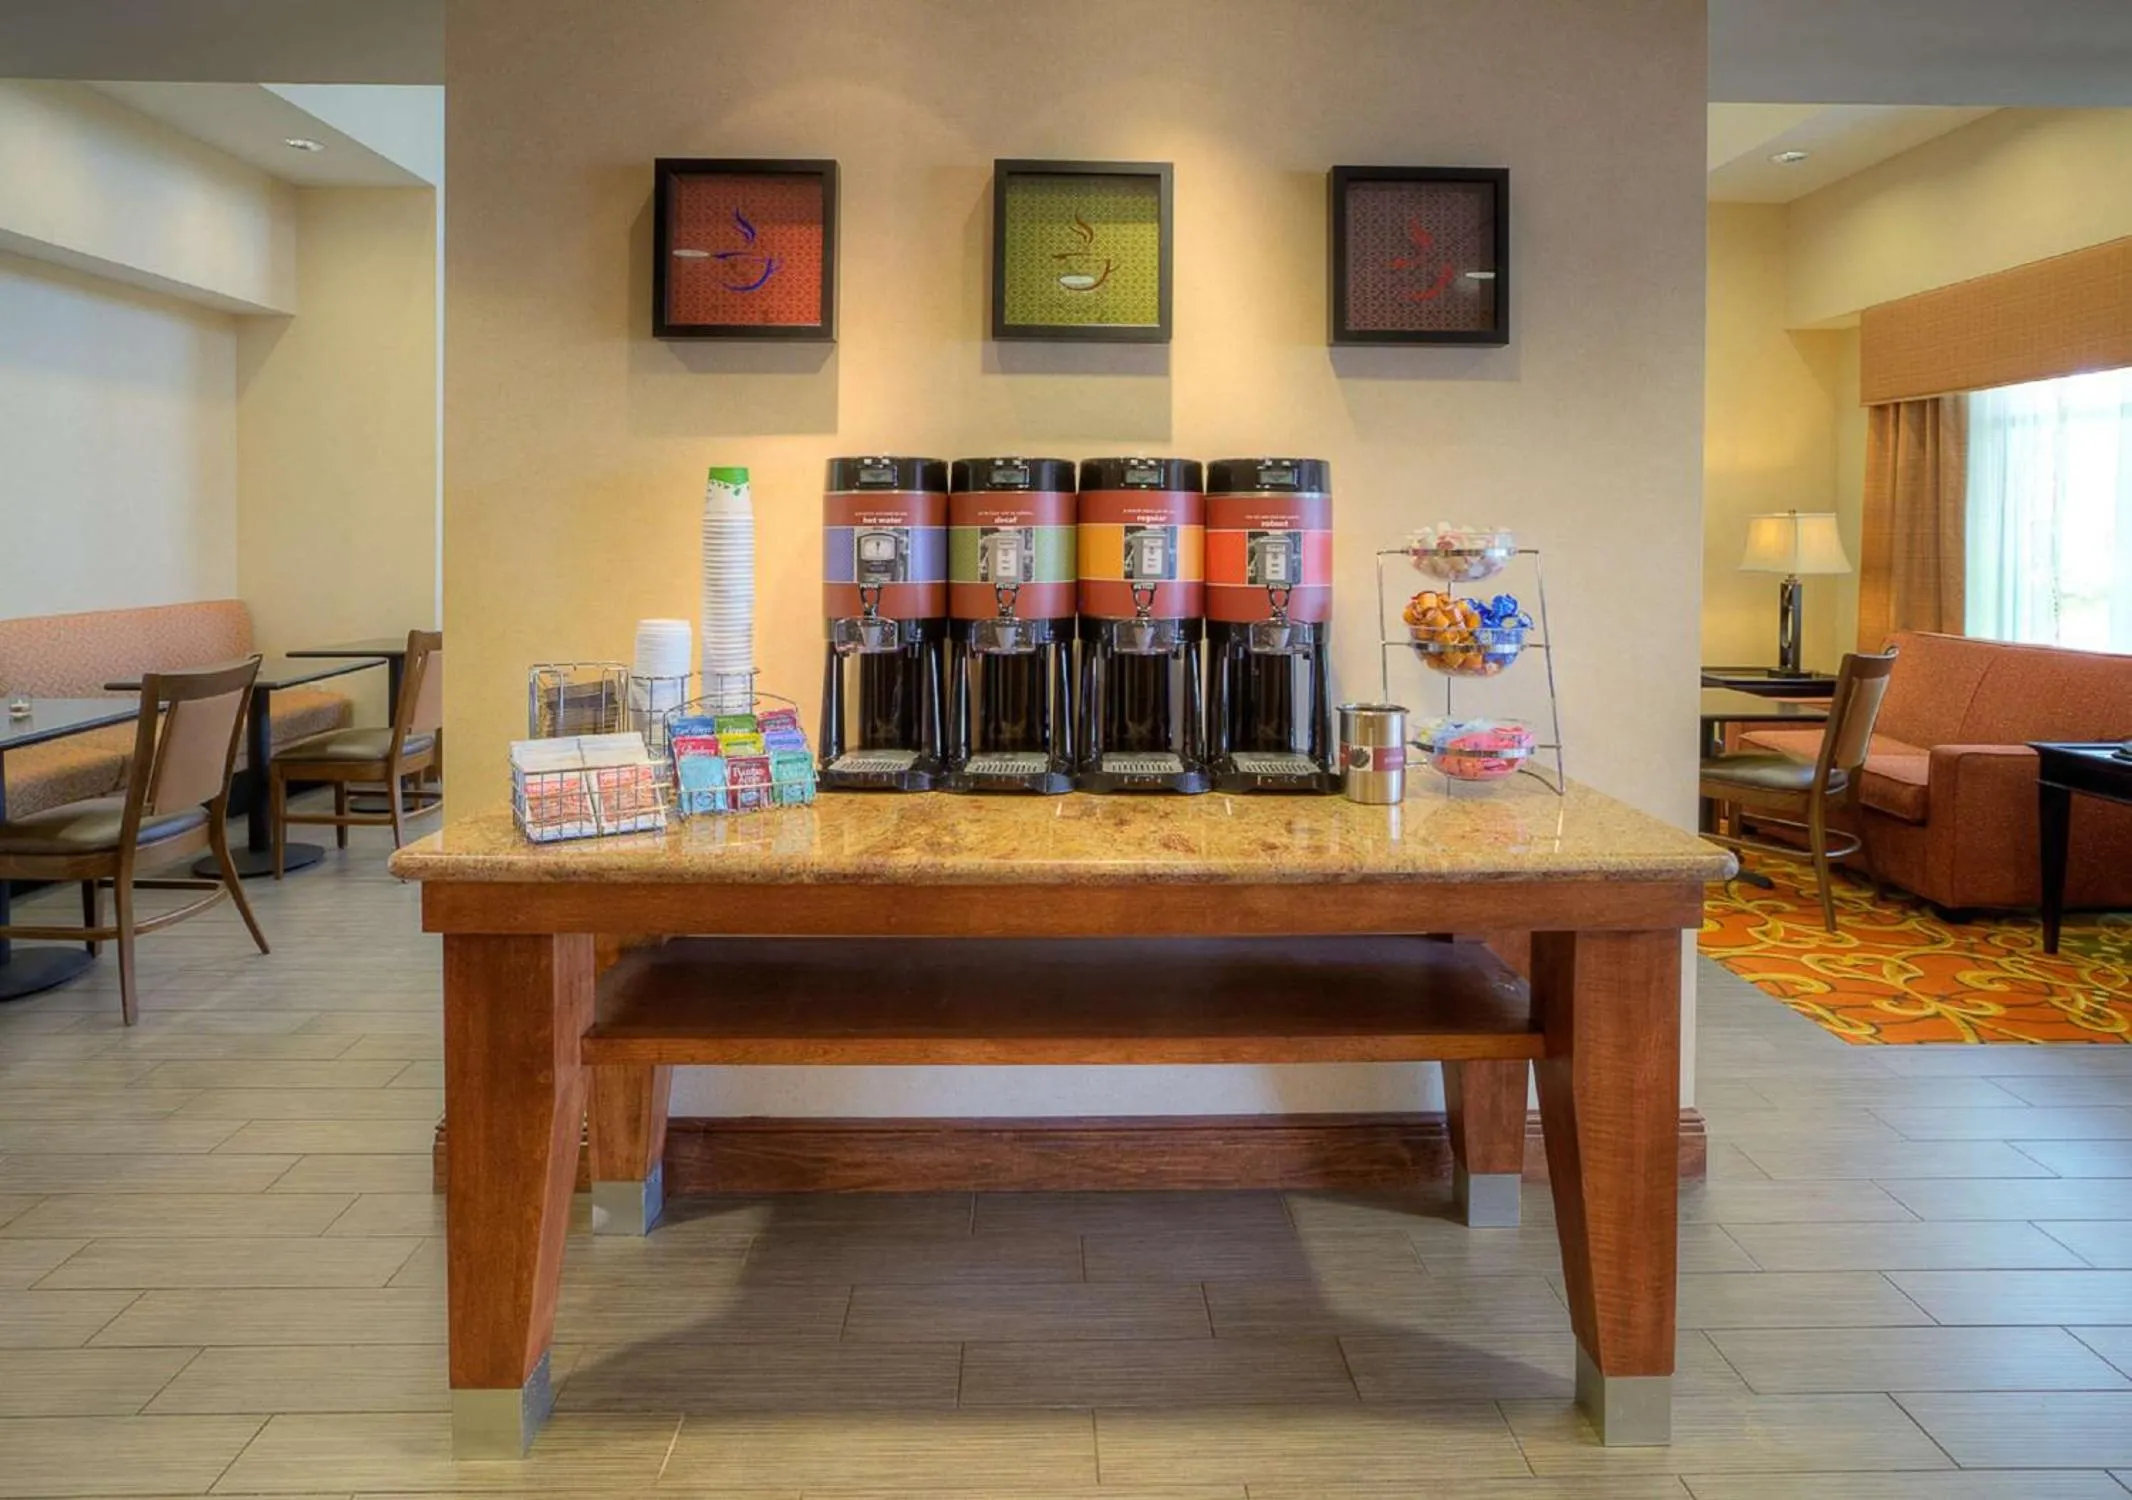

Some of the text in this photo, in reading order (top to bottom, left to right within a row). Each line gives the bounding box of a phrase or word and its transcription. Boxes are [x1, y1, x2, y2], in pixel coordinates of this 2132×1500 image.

[862, 516, 877, 524] hot
[994, 516, 1018, 524] decaf
[1136, 514, 1167, 523] regular
[1260, 519, 1289, 527] robust
